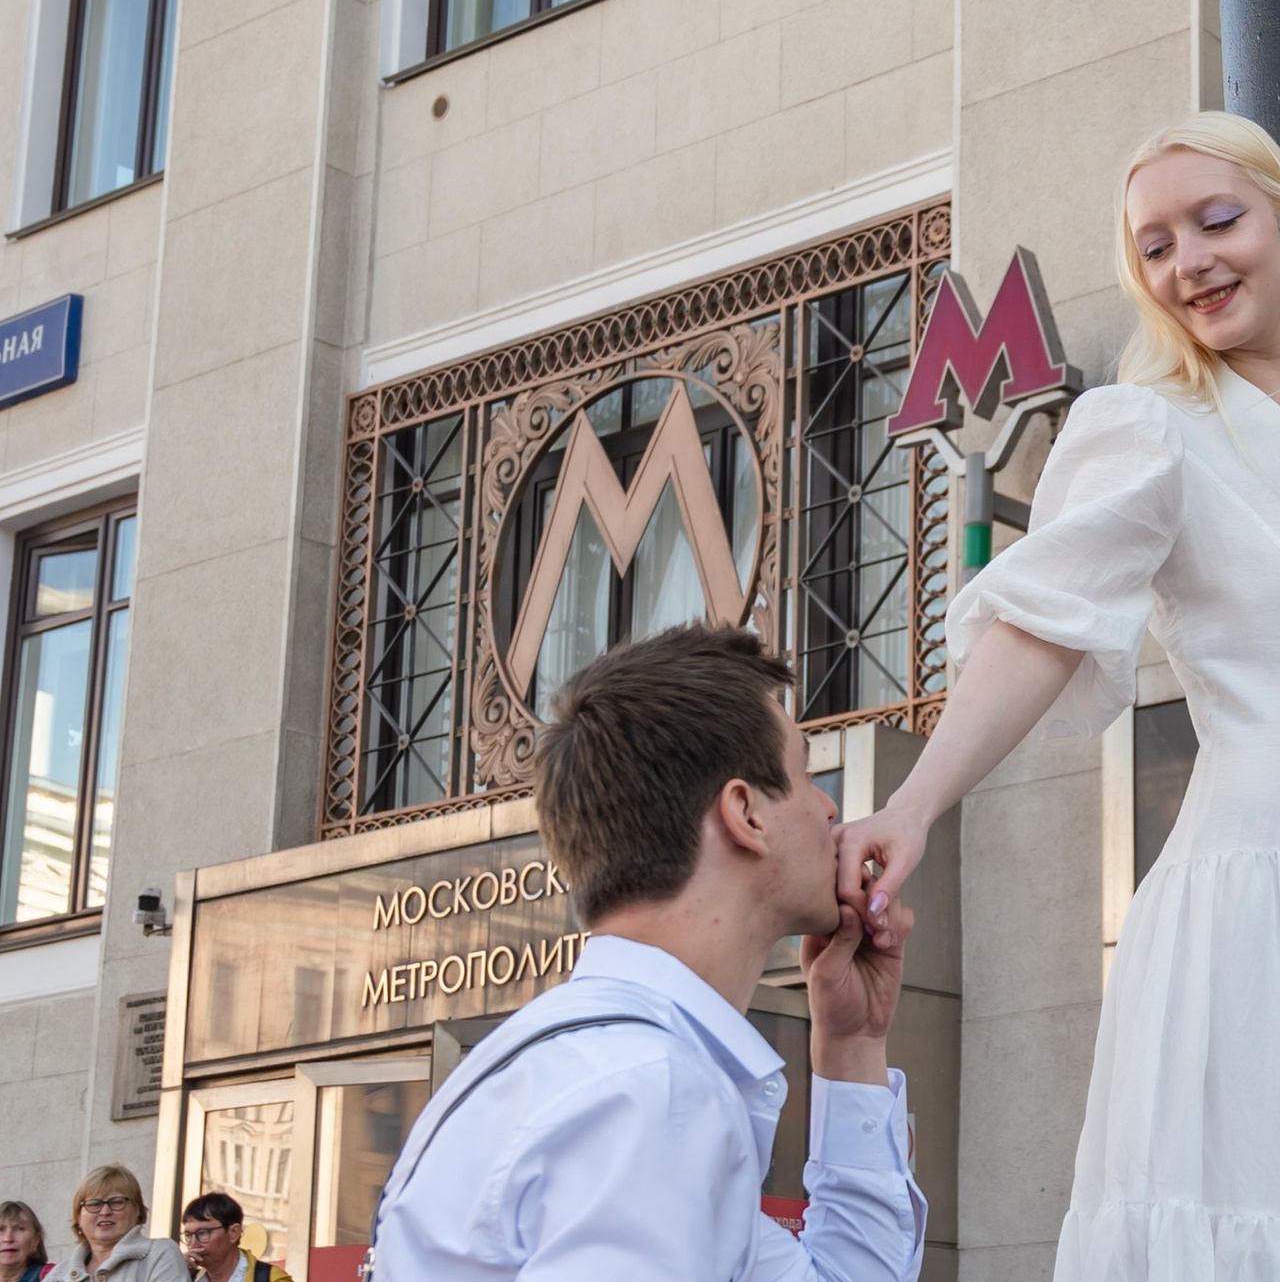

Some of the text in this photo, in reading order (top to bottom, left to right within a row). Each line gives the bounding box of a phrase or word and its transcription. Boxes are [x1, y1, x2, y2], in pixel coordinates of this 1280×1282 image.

[0, 324, 44, 364] НАЯ
[373, 860, 570, 930] МОСКОВСК
[770, 1216, 803, 1231] хода
